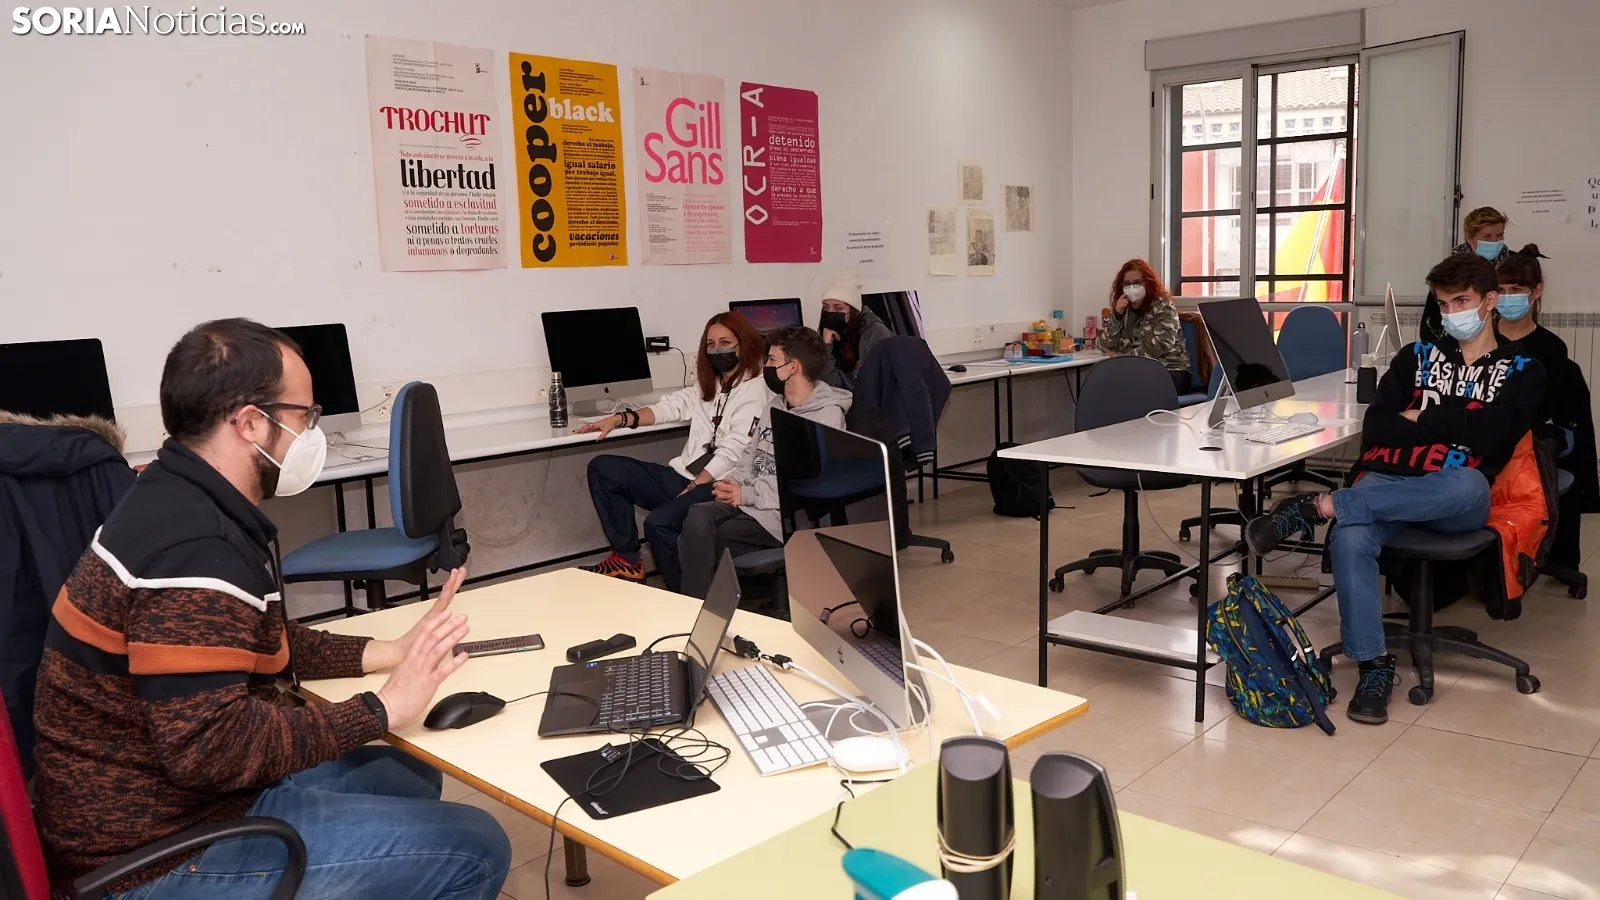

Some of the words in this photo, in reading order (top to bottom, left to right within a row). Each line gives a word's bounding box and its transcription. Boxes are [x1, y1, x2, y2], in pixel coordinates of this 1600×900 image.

[547, 97, 615, 123] black
[379, 106, 491, 135] TROCHUT
[665, 97, 721, 150] Gill
[768, 134, 815, 148] detenido
[520, 60, 557, 262] cooper
[564, 160, 585, 169] igual
[588, 161, 616, 170] salario
[643, 132, 724, 186] Sans
[400, 159, 496, 190] libertad
[404, 197, 445, 209] sometido
[447, 200, 452, 208] a
[454, 198, 496, 209] esclavitud
[406, 222, 450, 234] sometido
[452, 225, 459, 234] a
[460, 223, 498, 234] torturas
[407, 236, 414, 245] ni
[422, 237, 444, 246] penas
[451, 236, 473, 245] tratos
[569, 231, 619, 240] vacaciones
[408, 246, 448, 256] inhumanos
